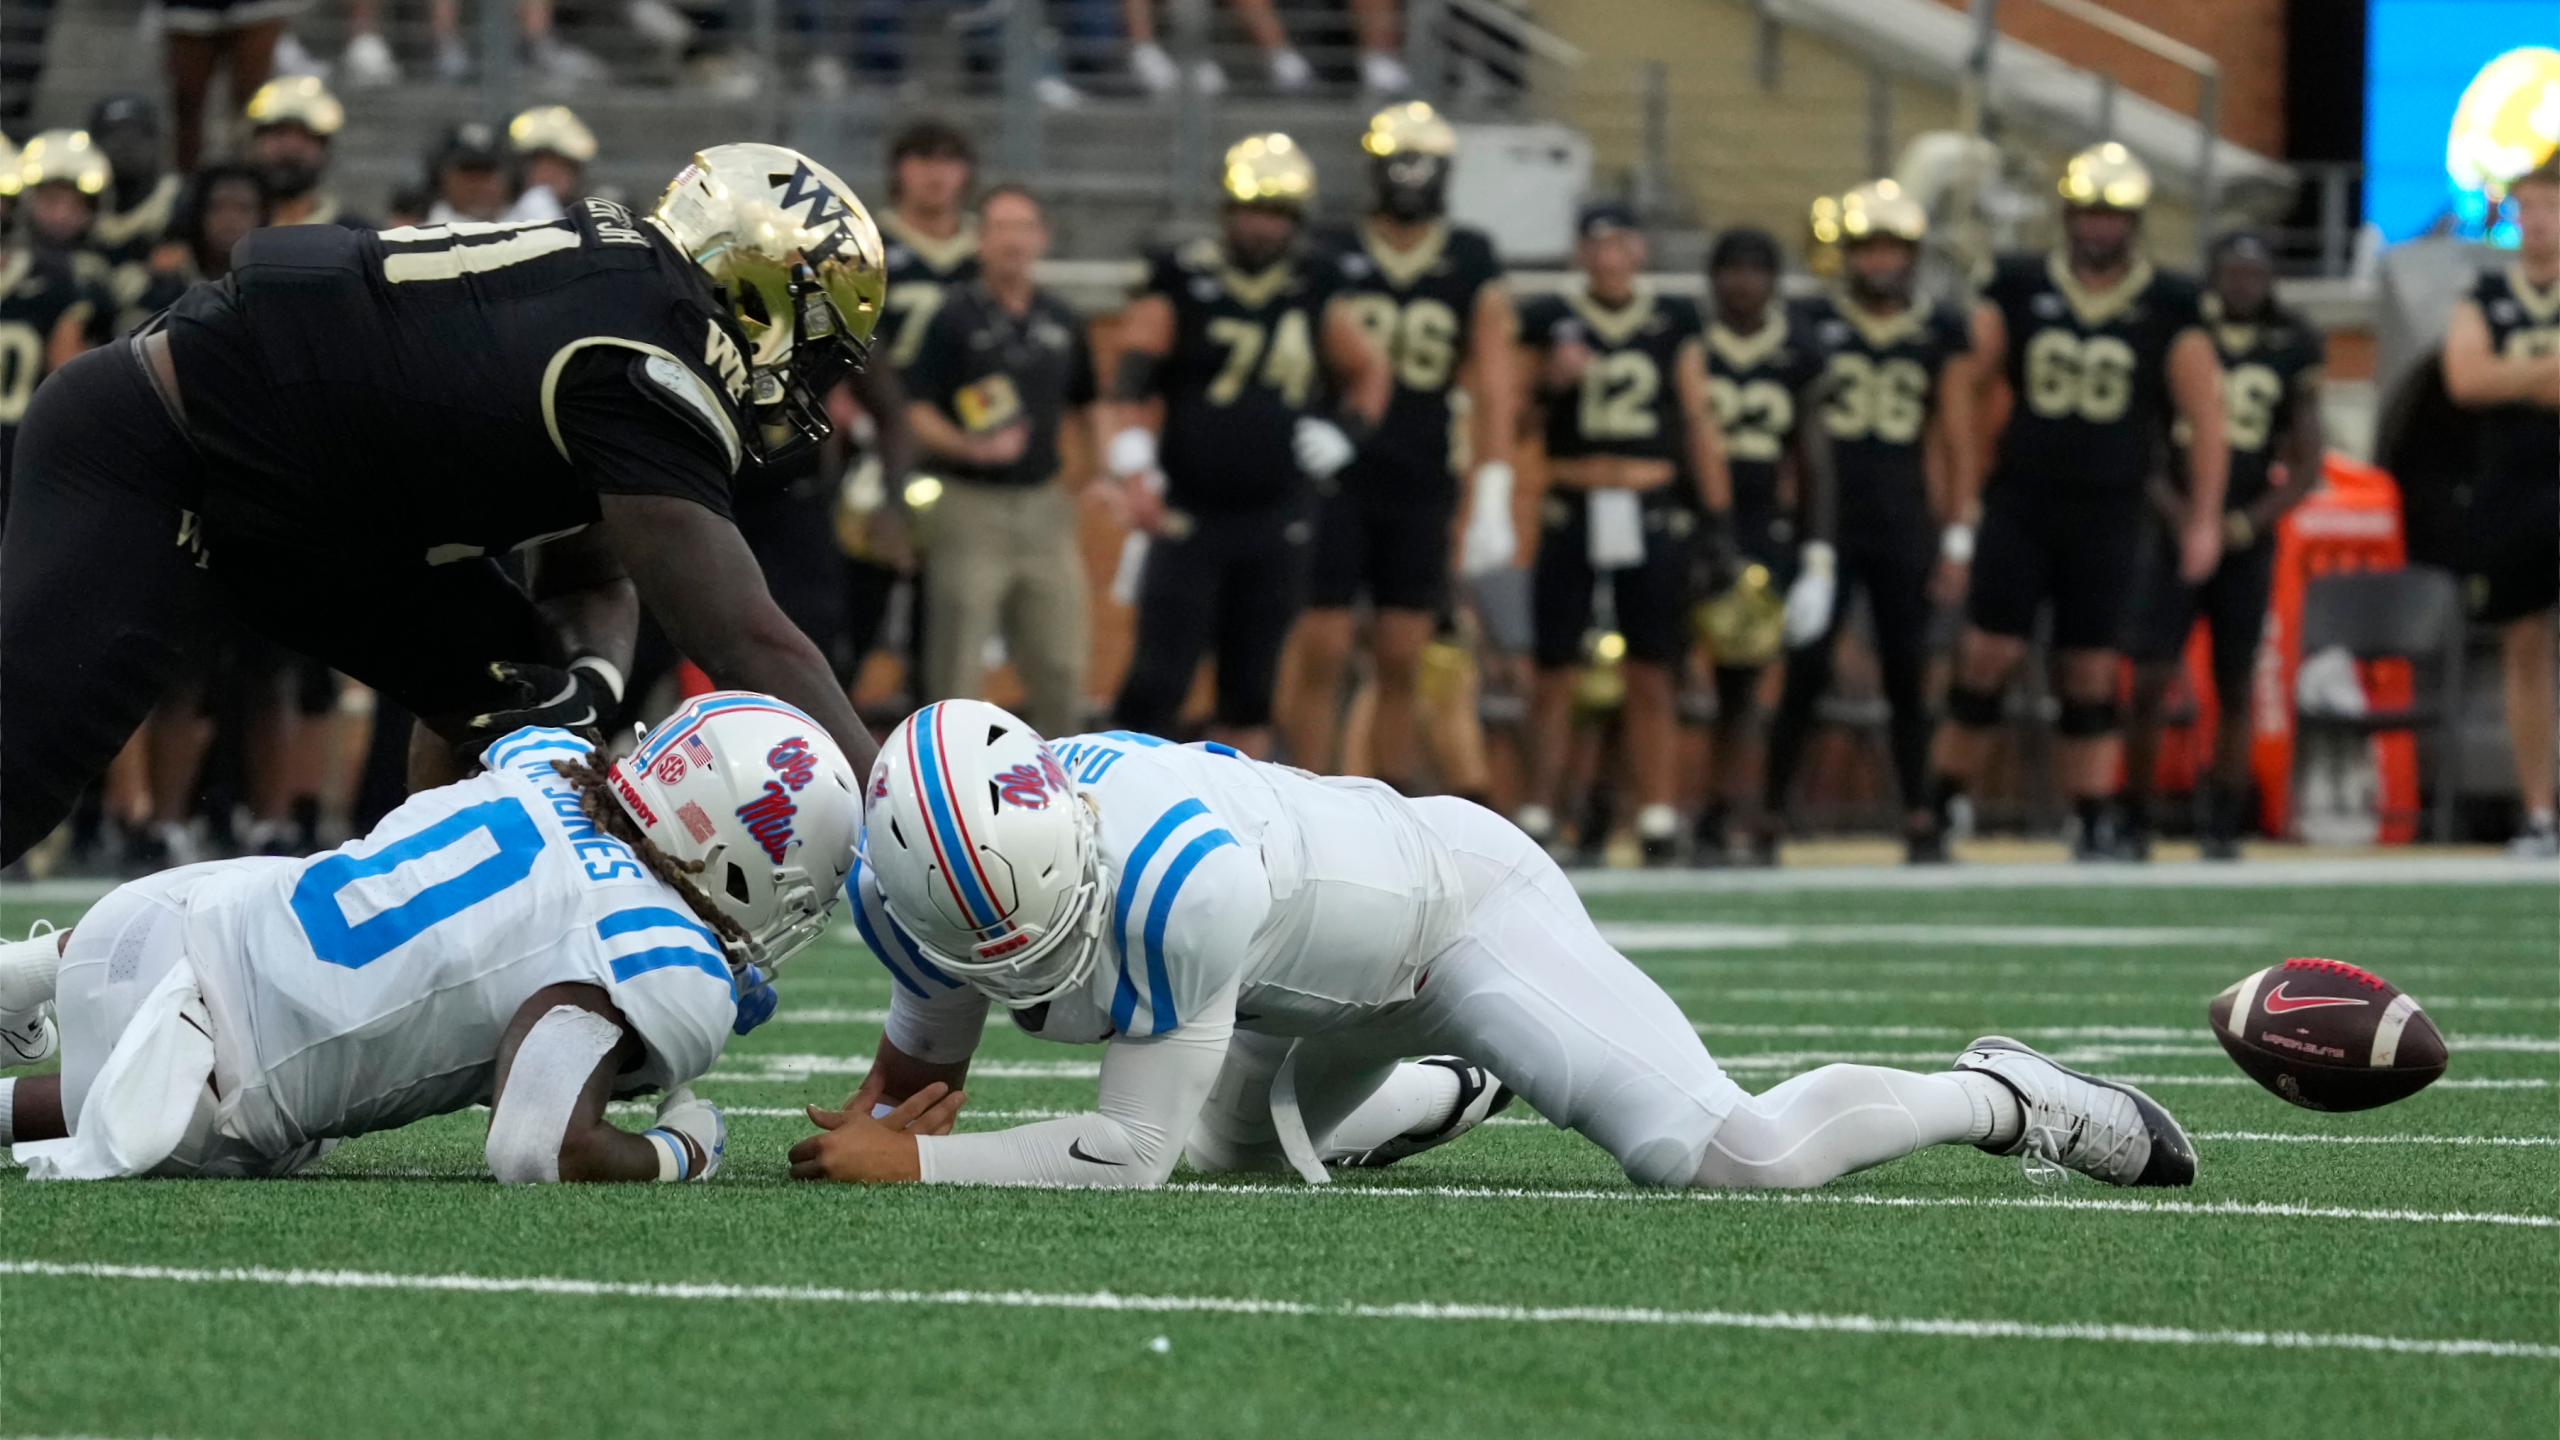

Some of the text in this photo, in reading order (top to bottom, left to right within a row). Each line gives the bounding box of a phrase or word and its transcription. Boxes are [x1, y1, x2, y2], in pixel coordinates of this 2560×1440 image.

[1205, 314, 1313, 408] 74
[1578, 351, 1661, 441] 12
[1824, 352, 1929, 445] 36
[2025, 328, 2135, 423] 66
[618, 778, 658, 829] TODDY
[657, 754, 687, 785] SEC
[541, 786, 643, 881] JONES
[290, 797, 546, 969] 0
